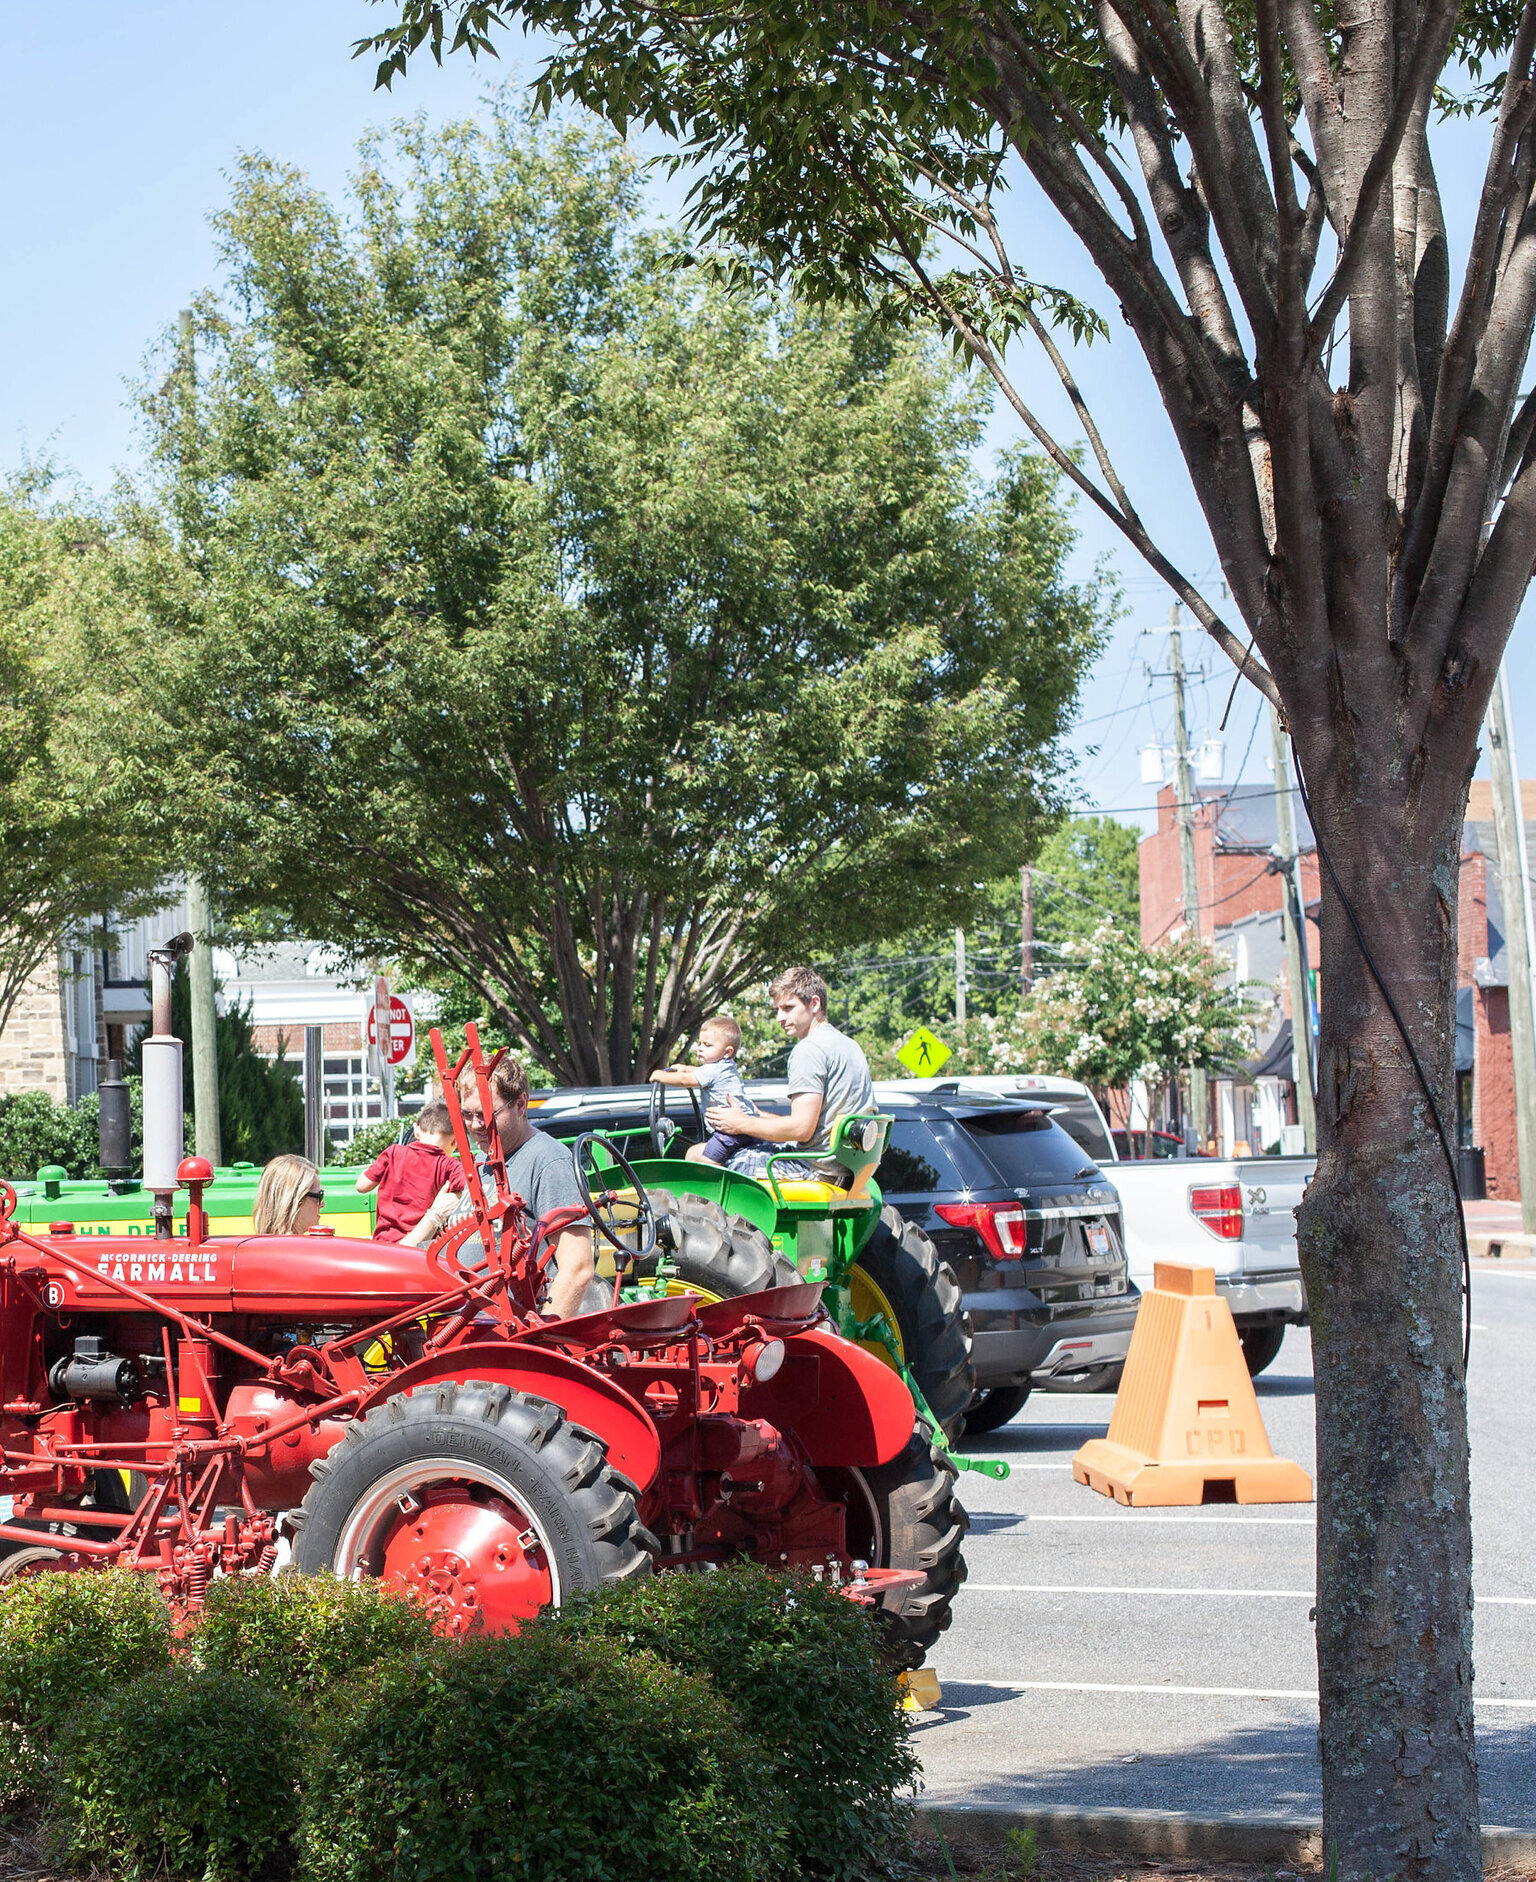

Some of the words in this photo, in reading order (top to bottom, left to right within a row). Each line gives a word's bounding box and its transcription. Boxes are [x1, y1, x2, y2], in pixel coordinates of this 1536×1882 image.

[97, 1263, 216, 1282] FARMALL
[48, 1286, 59, 1305] B
[431, 1430, 520, 1473] DENMAN
[1185, 1429, 1246, 1456] CPD
[530, 1480, 575, 1545] FARM
